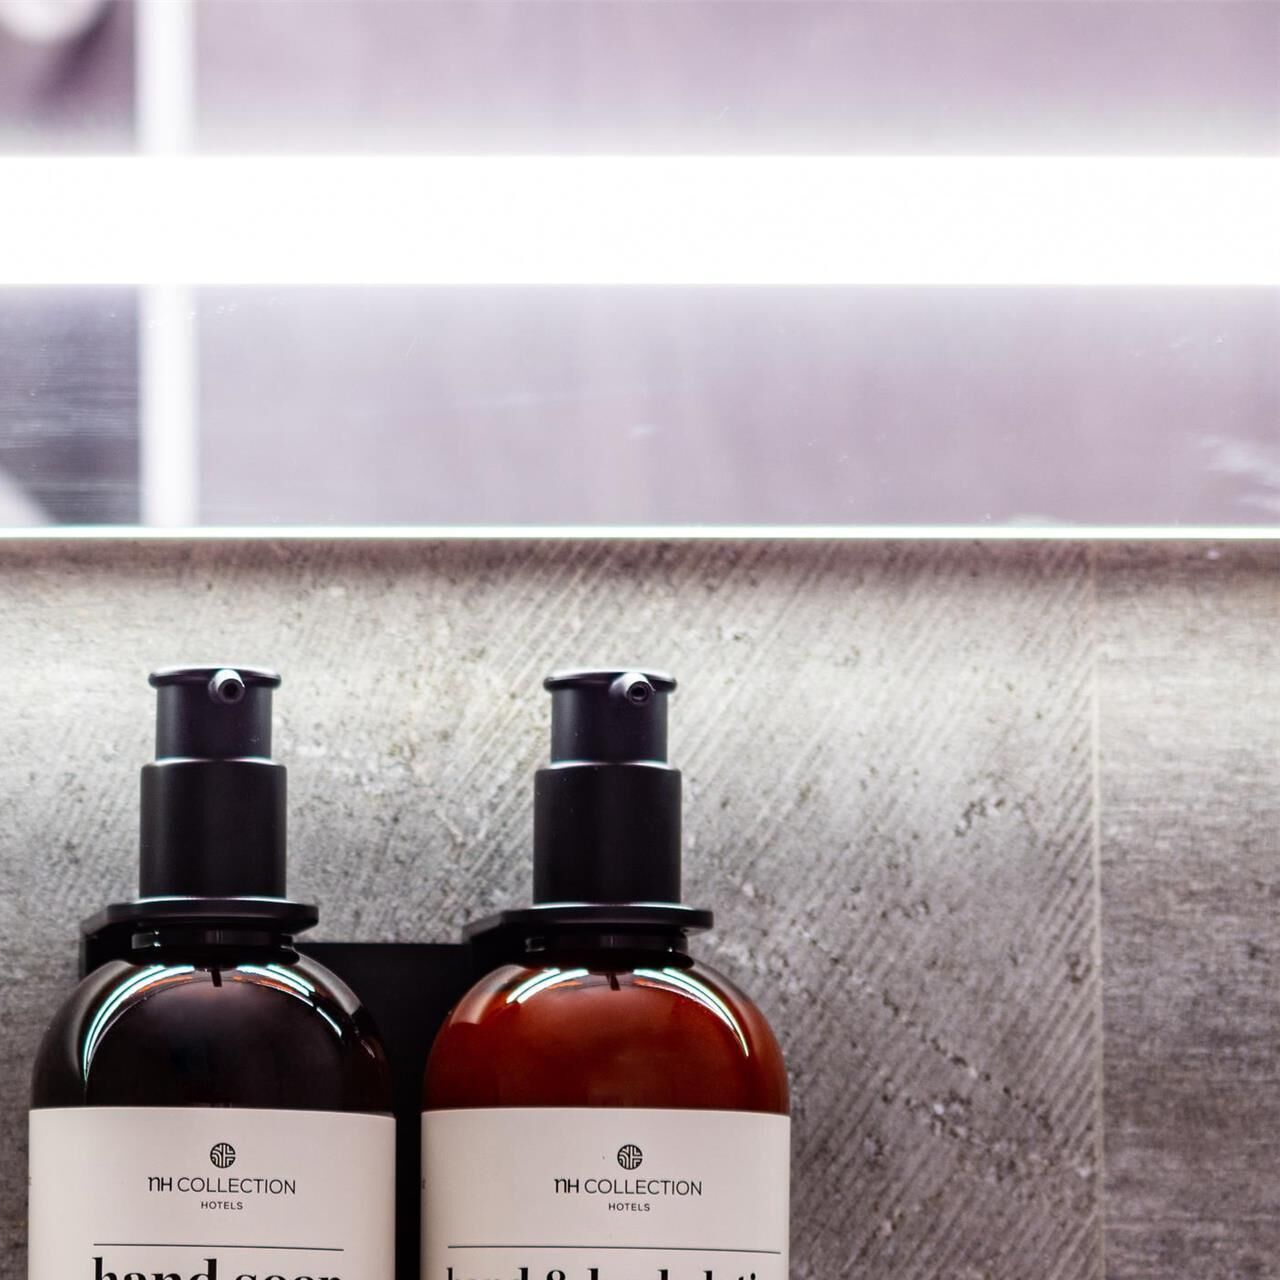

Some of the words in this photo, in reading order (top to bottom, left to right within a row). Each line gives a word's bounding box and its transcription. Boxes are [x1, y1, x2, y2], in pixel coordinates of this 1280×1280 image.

[177, 1178, 297, 1195] COLLECTION
[584, 1179, 703, 1196] COLLECTION
[201, 1201, 244, 1210] HOTELS
[608, 1203, 651, 1212] HOTELS
